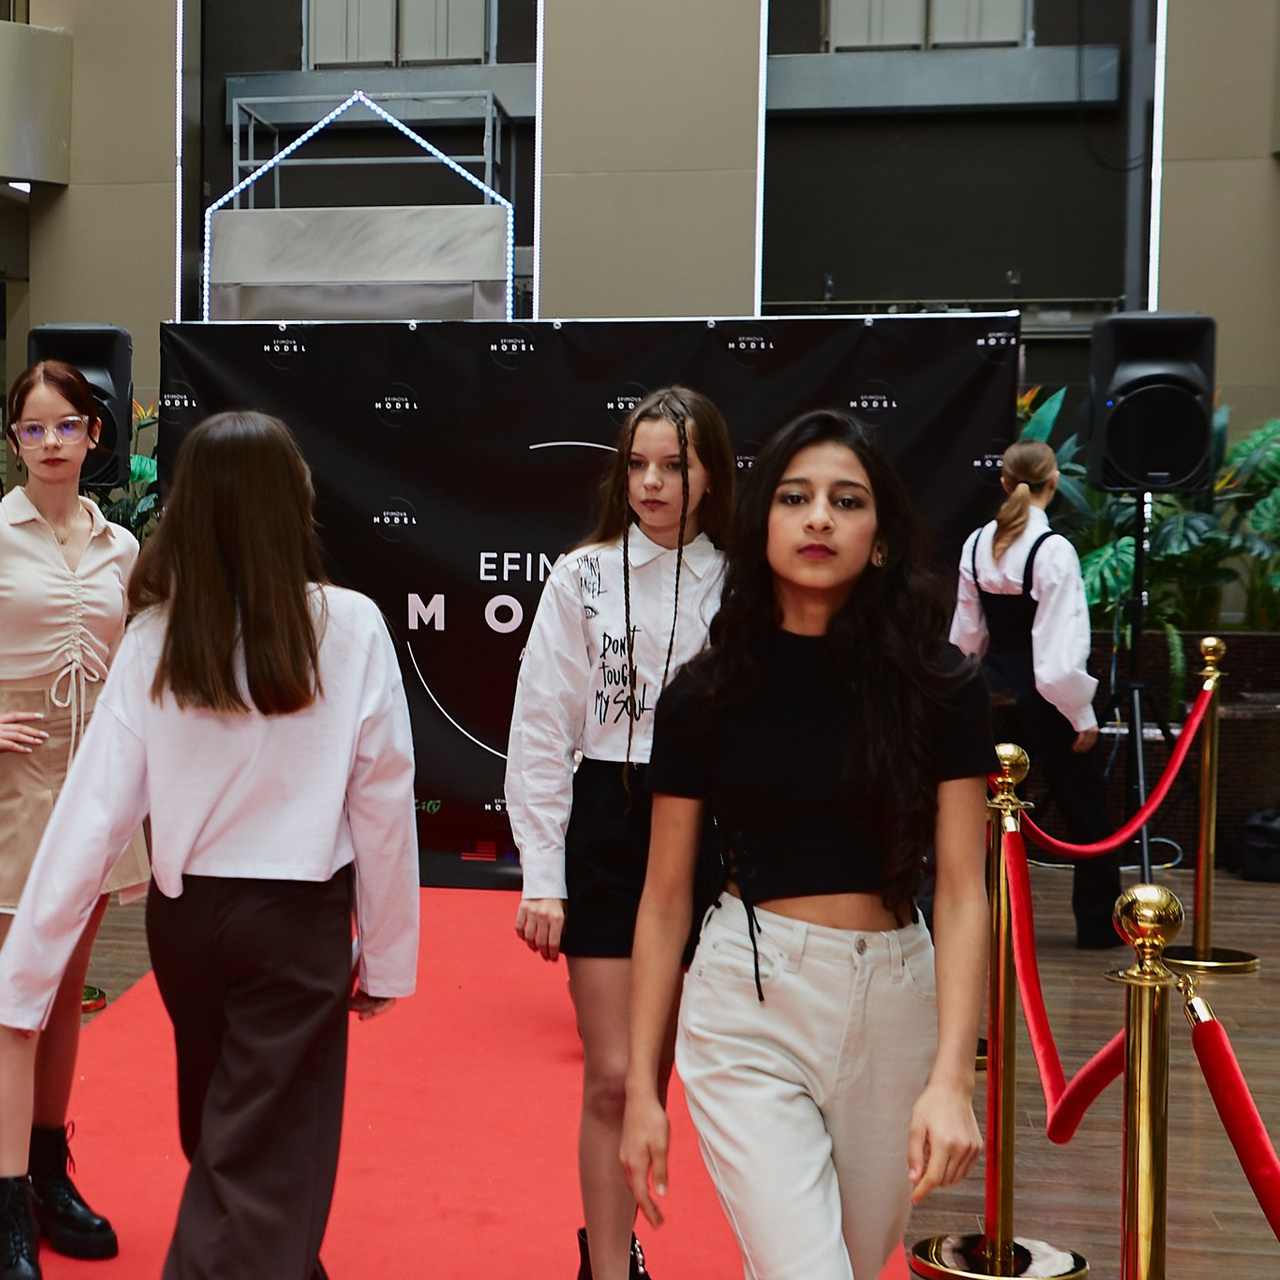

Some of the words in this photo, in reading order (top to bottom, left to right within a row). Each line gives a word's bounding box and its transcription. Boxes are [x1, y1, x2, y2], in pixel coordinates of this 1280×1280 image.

[976, 337, 1017, 346] MODE
[607, 402, 635, 410] MOD
[972, 459, 1004, 468] MOD
[480, 552, 566, 582] EFIM
